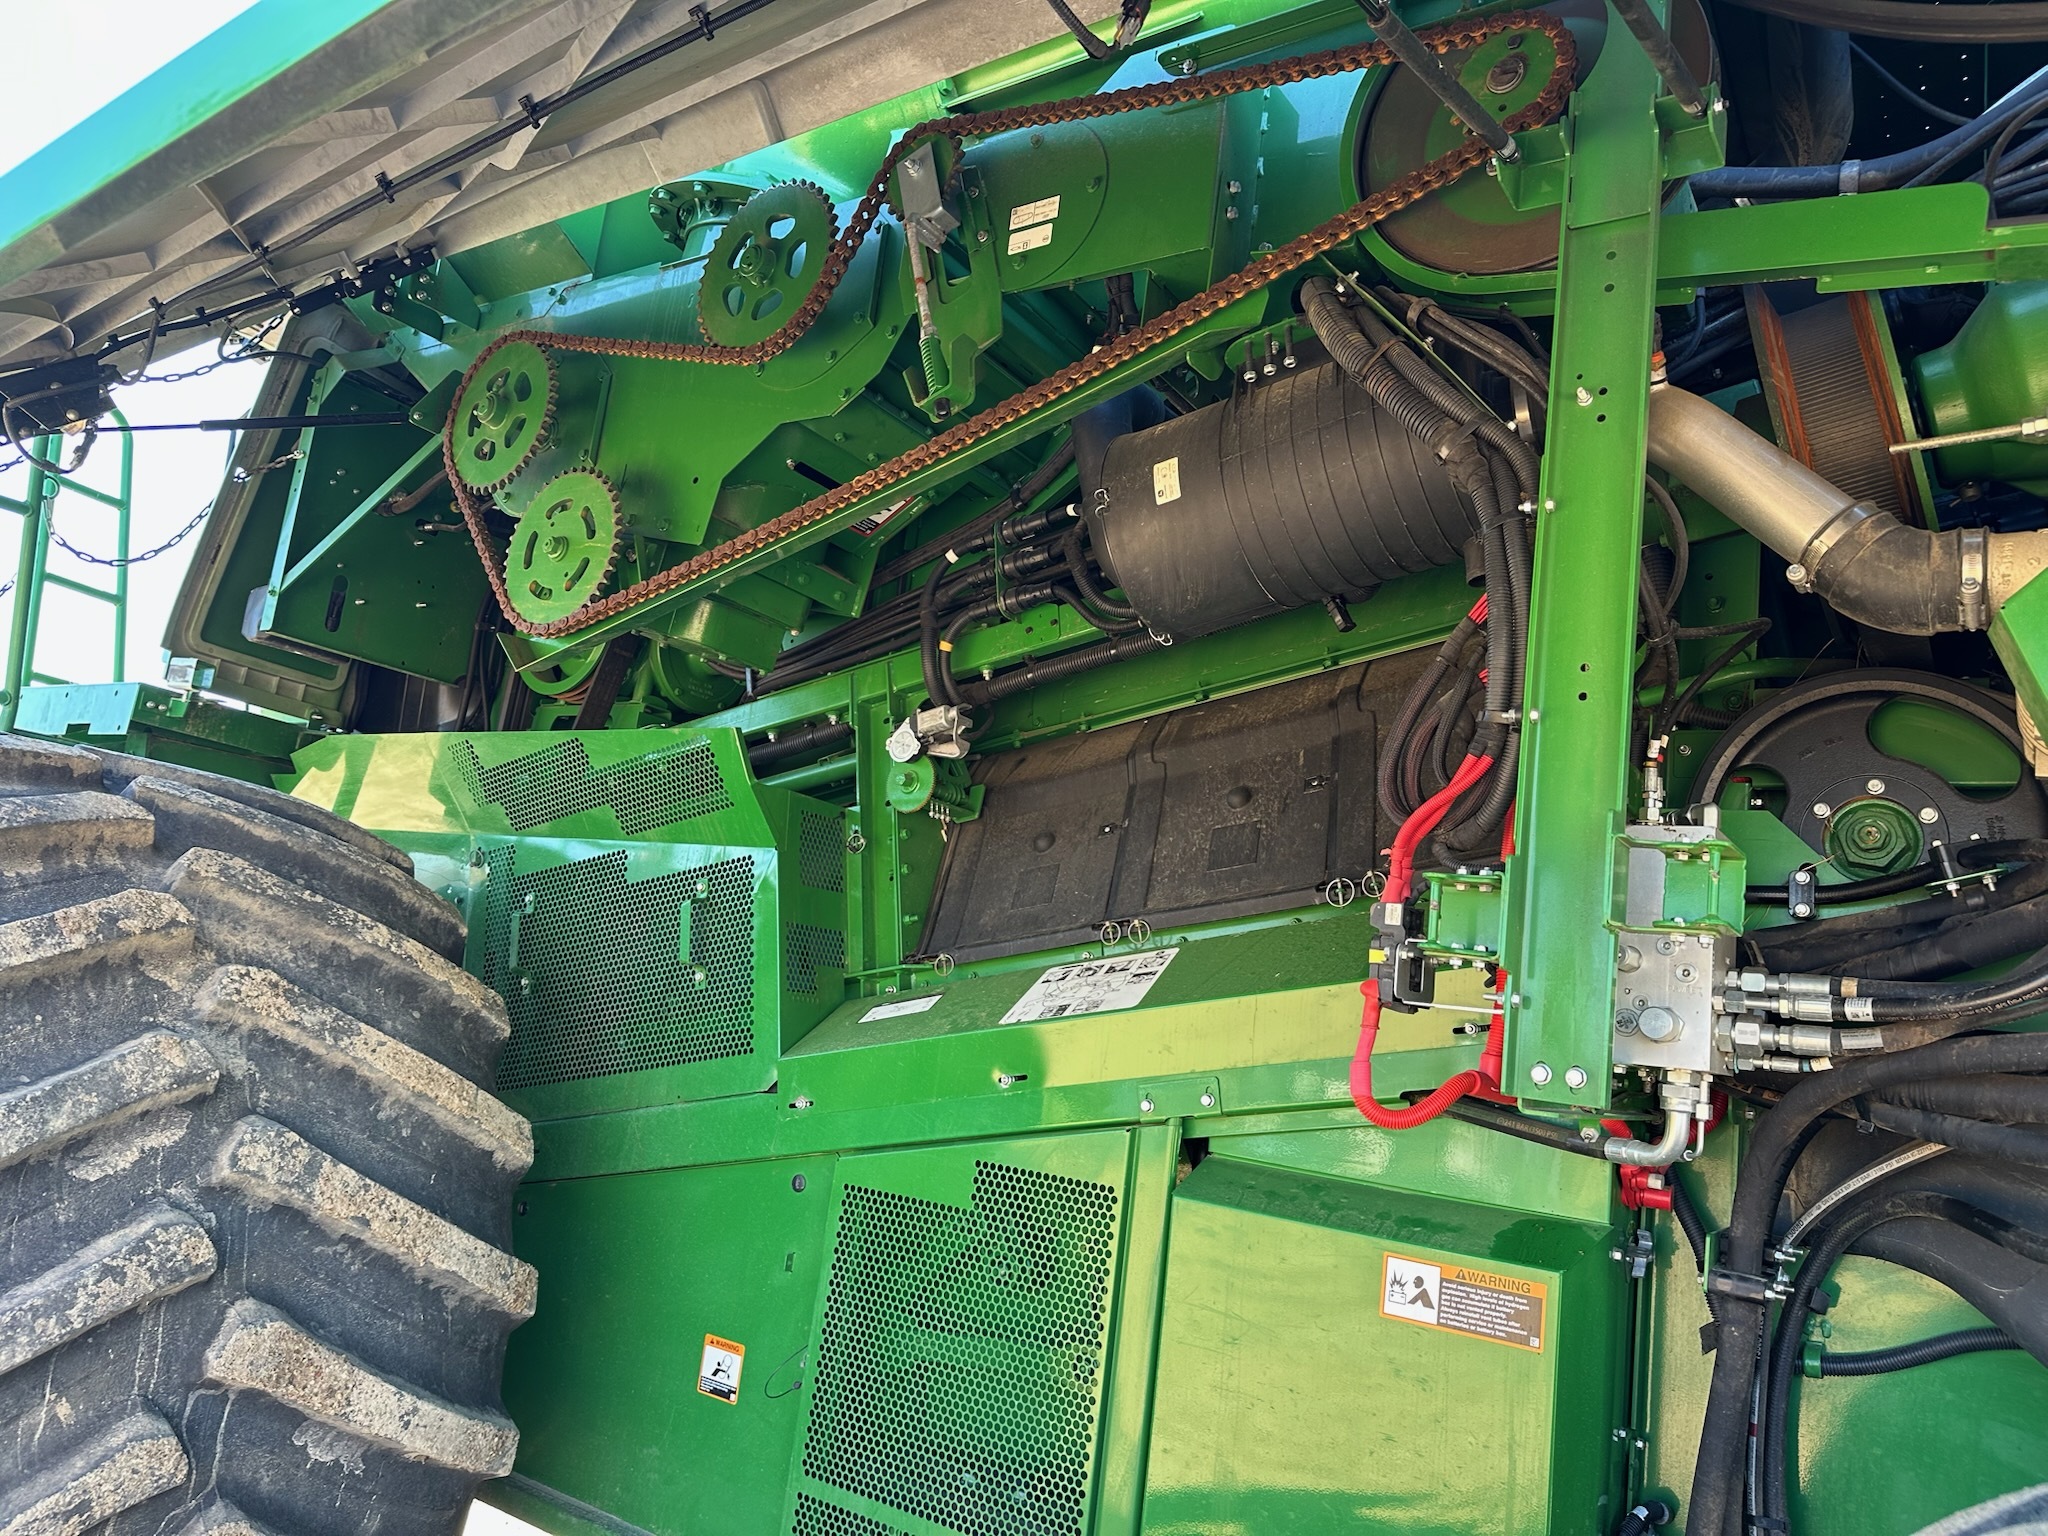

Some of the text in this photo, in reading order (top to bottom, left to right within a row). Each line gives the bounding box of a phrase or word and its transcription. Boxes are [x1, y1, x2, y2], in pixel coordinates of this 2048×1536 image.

[1515, 1122, 1528, 1131] BAR
[1832, 1188, 1844, 1197] MAX
[1859, 1172, 1871, 1182] BAR
[1884, 1161, 1894, 1169] PSI
[1468, 1272, 1531, 1294] WARNING
[1441, 1288, 1467, 1298] explosion.
[1504, 1301, 1529, 1311] hydrogen
[1476, 1289, 1491, 1297] injury
[1499, 1293, 1513, 1301] death
[1440, 1306, 1458, 1314] Always
[1459, 1310, 1479, 1318] reinstall
[1461, 1298, 1490, 1308] accumulate
[1495, 1305, 1514, 1314] battery
[1466, 1305, 1483, 1313] vented
[1483, 1309, 1506, 1319] properly.
[1439, 1312, 1467, 1323] performing
[1468, 1318, 1486, 1326] service
[1494, 1324, 1527, 1335] maintenance
[1447, 1319, 1469, 1329] batteries
[1476, 1326, 1494, 1335] battery
[715, 1339, 739, 1353] WARNING
